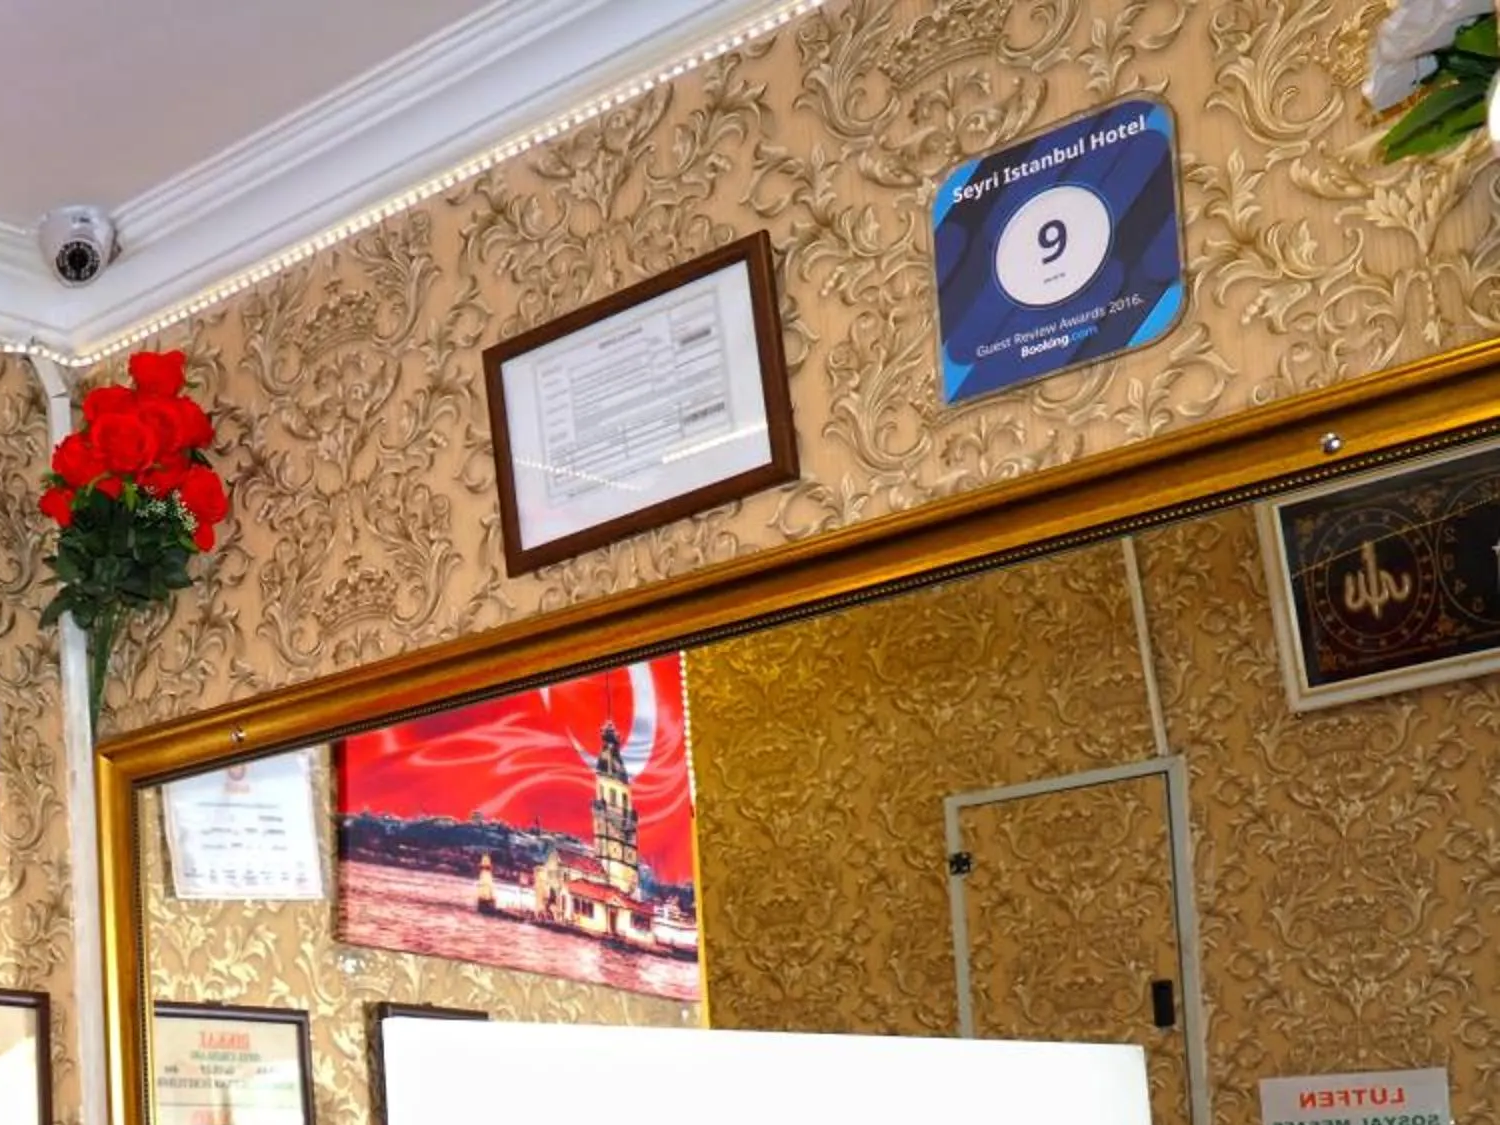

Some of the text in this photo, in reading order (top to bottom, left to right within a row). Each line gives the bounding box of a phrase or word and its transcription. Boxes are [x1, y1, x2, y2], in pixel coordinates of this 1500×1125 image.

[952, 113, 1148, 204] Seyri Istanbul Hotel
[1037, 218, 1068, 265] 9
[976, 338, 1012, 358] Guest
[1014, 320, 1057, 344] Review
[1059, 304, 1106, 330] Awards
[1020, 325, 1099, 359] Booking.com
